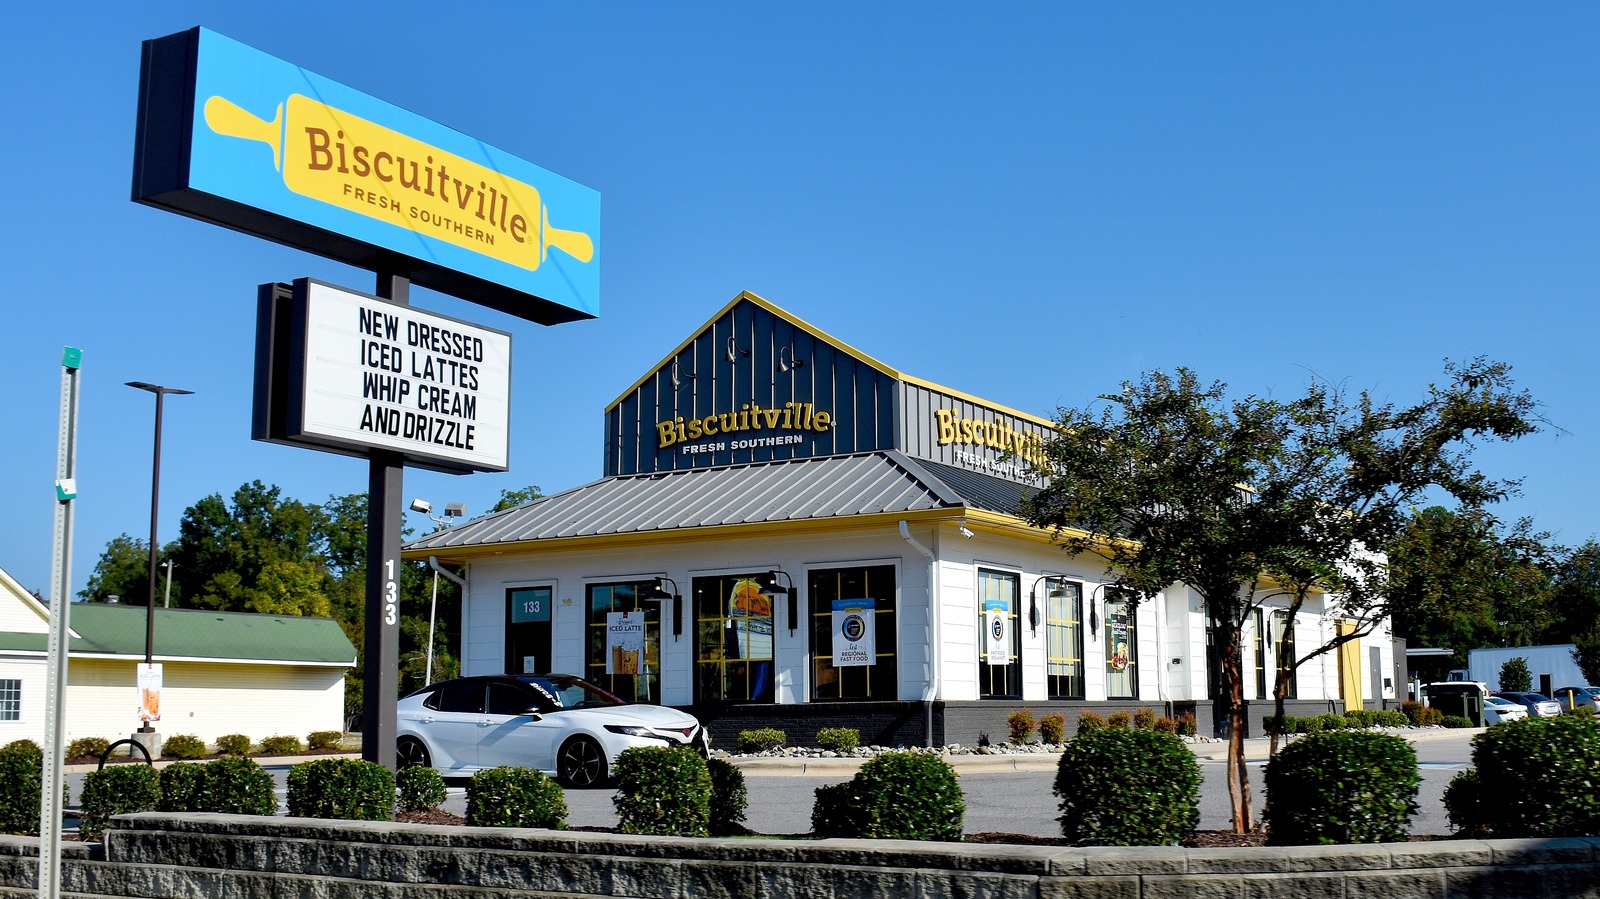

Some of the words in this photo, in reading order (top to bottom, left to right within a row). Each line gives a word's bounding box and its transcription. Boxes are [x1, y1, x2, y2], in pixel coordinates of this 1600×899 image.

[304, 127, 527, 244] Biscuitville
[343, 183, 401, 213] FRESH
[409, 206, 495, 246] SOUTHERN
[360, 307, 399, 342] NEW
[408, 320, 483, 363] DRESSED
[361, 339, 402, 374] ICED
[412, 352, 479, 391] LATTES
[363, 371, 410, 405] WHIP
[418, 384, 477, 421] CREAM
[360, 404, 400, 437] AND
[403, 411, 475, 451] DRIZZLE
[656, 402, 831, 448] Biscuitville
[683, 442, 725, 455] FRESH
[730, 434, 803, 450] SOUTHERN
[957, 449, 988, 468] FRESH
[991, 459, 1037, 481] SOUTHE
[385, 558, 397, 626] 133
[523, 601, 540, 613] 133
